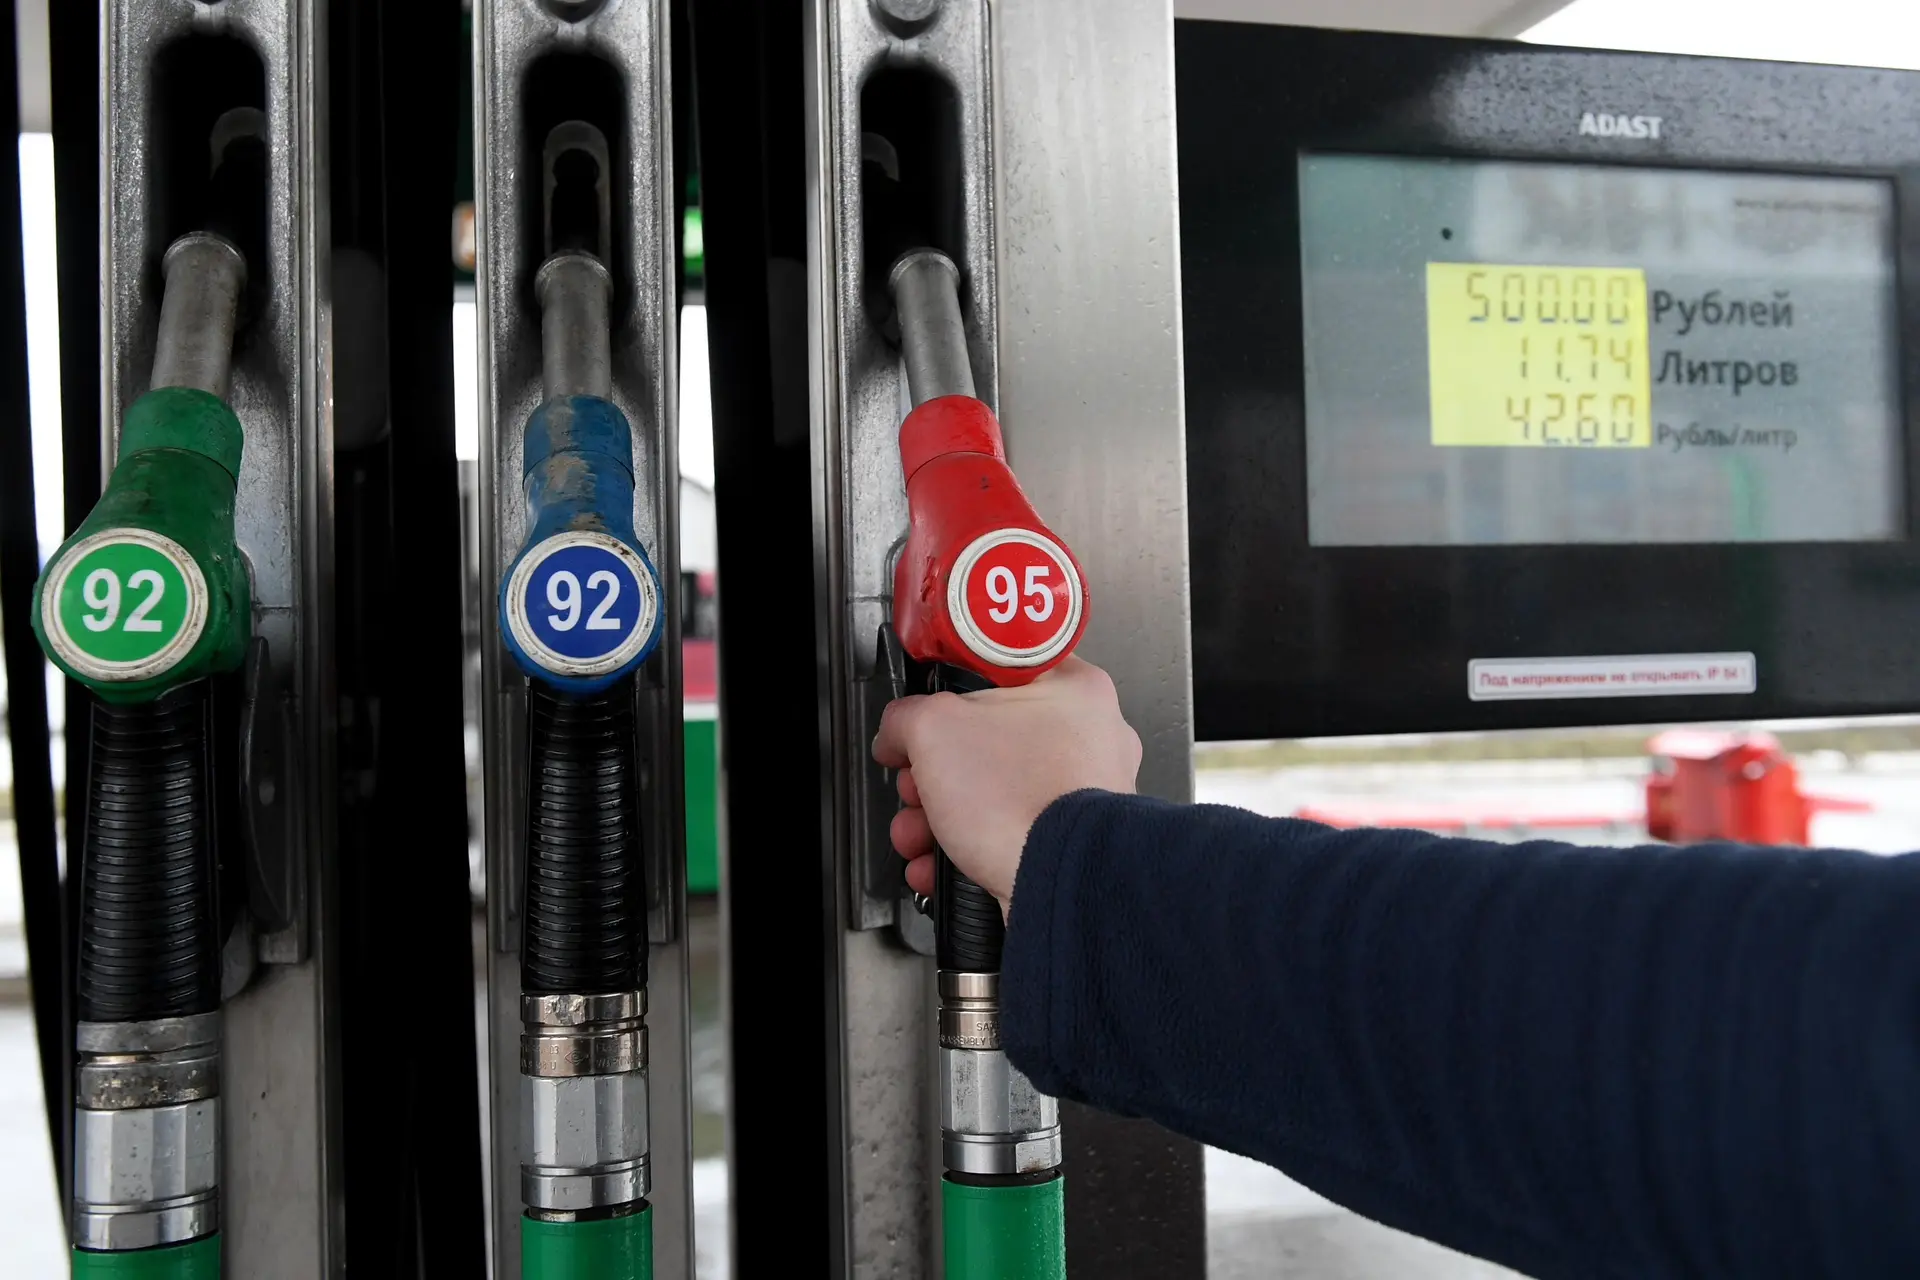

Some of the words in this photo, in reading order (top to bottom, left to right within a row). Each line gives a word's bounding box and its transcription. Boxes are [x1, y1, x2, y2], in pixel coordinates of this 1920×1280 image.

[1579, 112, 1663, 139] ADAST
[1466, 271, 1630, 325] 500.00
[1652, 290, 1793, 335] Рублей
[1520, 335, 1633, 382] 11.74
[1656, 350, 1799, 396] Литров
[1506, 393, 1635, 443] 42.60
[81, 568, 166, 633] 92
[545, 569, 622, 631] 92
[985, 565, 1054, 624] 95
[1480, 673, 1509, 687] Под
